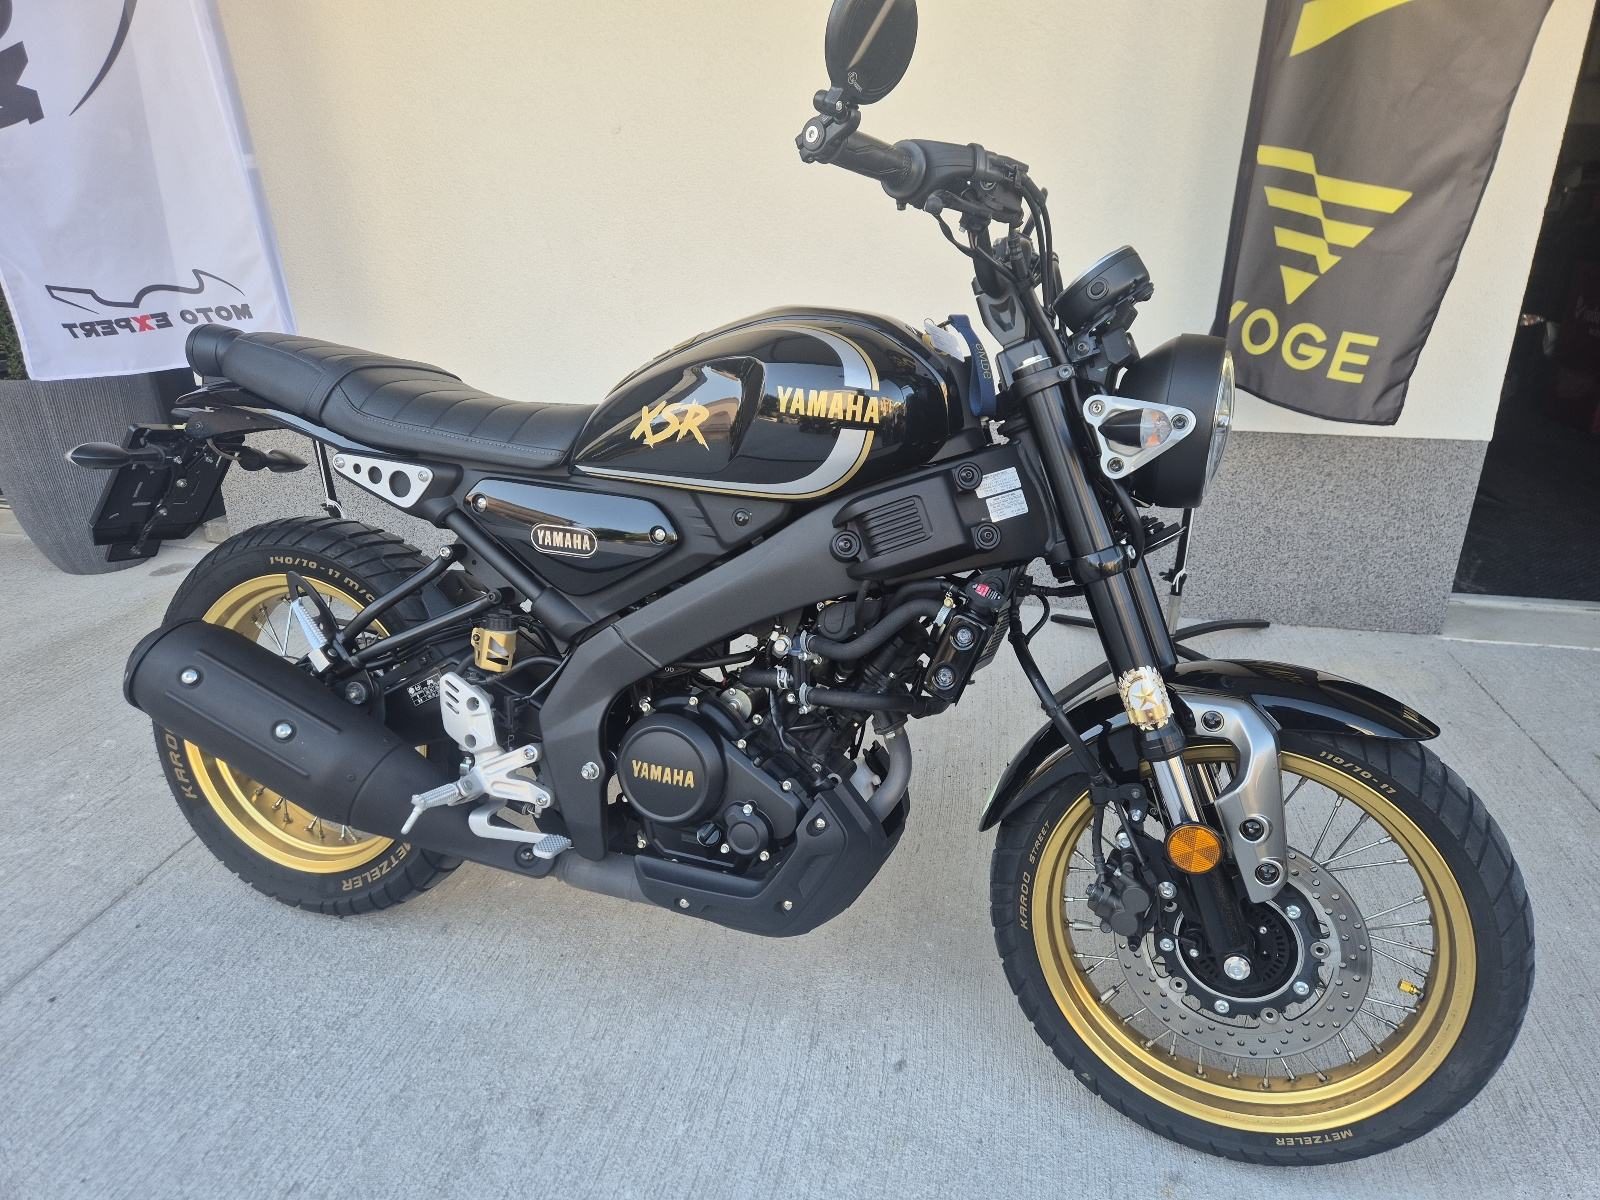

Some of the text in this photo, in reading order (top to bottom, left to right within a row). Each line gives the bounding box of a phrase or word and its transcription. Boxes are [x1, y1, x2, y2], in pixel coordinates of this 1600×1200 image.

[777, 386, 880, 424] YAMAHA
[630, 399, 709, 451] XSR
[537, 529, 591, 551] YAMAHA
[632, 759, 695, 789] YAMAHA
[1029, 820, 1050, 864] STREET
[1275, 1129, 1353, 1146] METZELER
